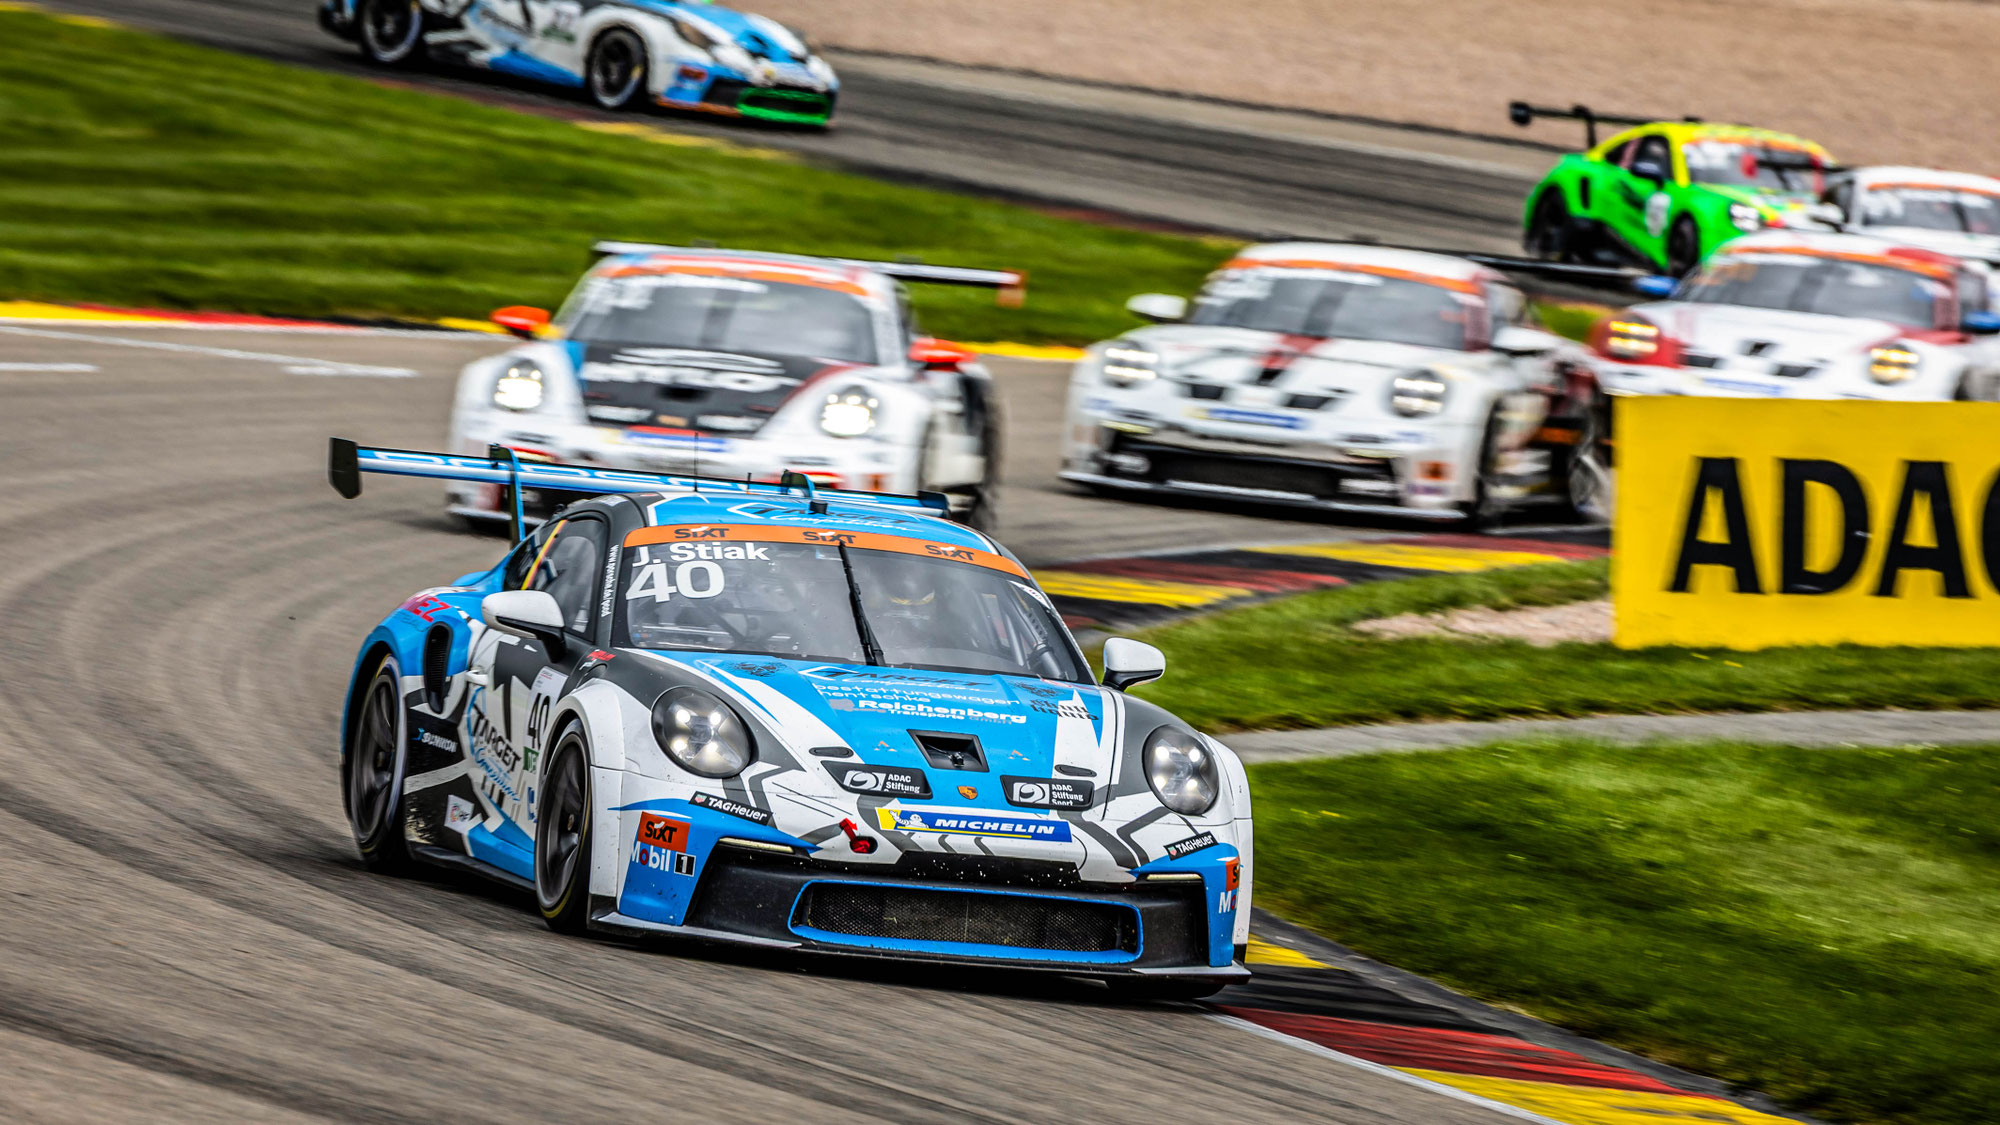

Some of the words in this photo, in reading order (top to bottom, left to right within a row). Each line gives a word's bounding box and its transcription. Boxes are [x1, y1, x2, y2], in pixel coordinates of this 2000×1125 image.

[1663, 455, 2000, 599] ADA
[632, 546, 661, 567] J.
[669, 541, 771, 562] Stiak
[625, 560, 726, 603] 40
[526, 692, 551, 751] 40
[858, 699, 1027, 724] Reichenberg
[887, 708, 965, 721] Transporte
[885, 781, 921, 794] Stiftung
[887, 773, 912, 783] ADAC
[1051, 783, 1073, 792] ADAC
[1051, 791, 1084, 802] Stiftung
[934, 818, 1056, 835] MICHELIN
[631, 840, 672, 873] Mobil
